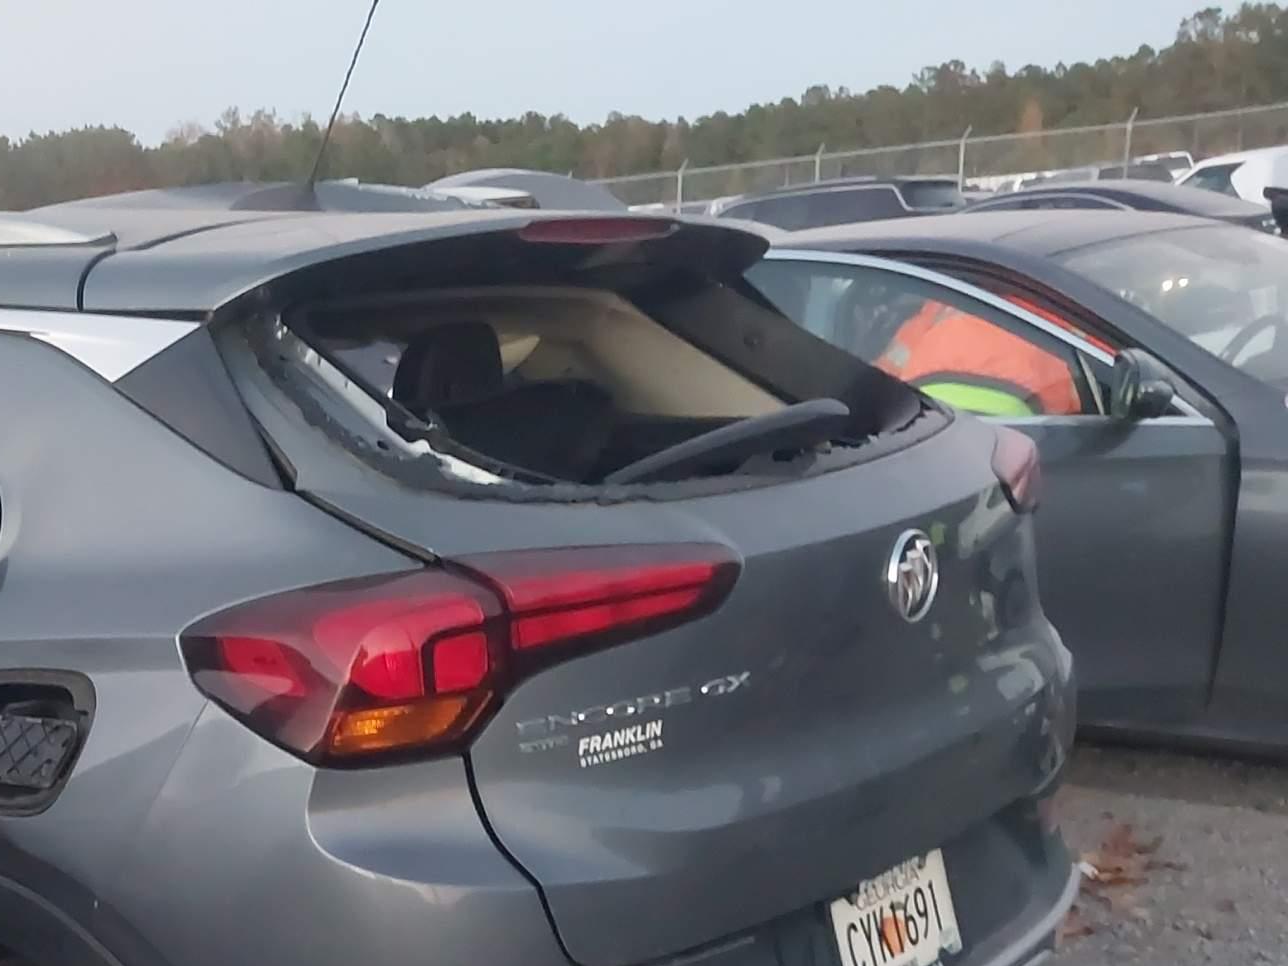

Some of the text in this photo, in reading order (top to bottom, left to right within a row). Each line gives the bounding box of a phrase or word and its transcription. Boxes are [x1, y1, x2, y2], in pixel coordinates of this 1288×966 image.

[516, 671, 751, 733] ENCORE GX
[578, 720, 663, 756] FRANKLIN
